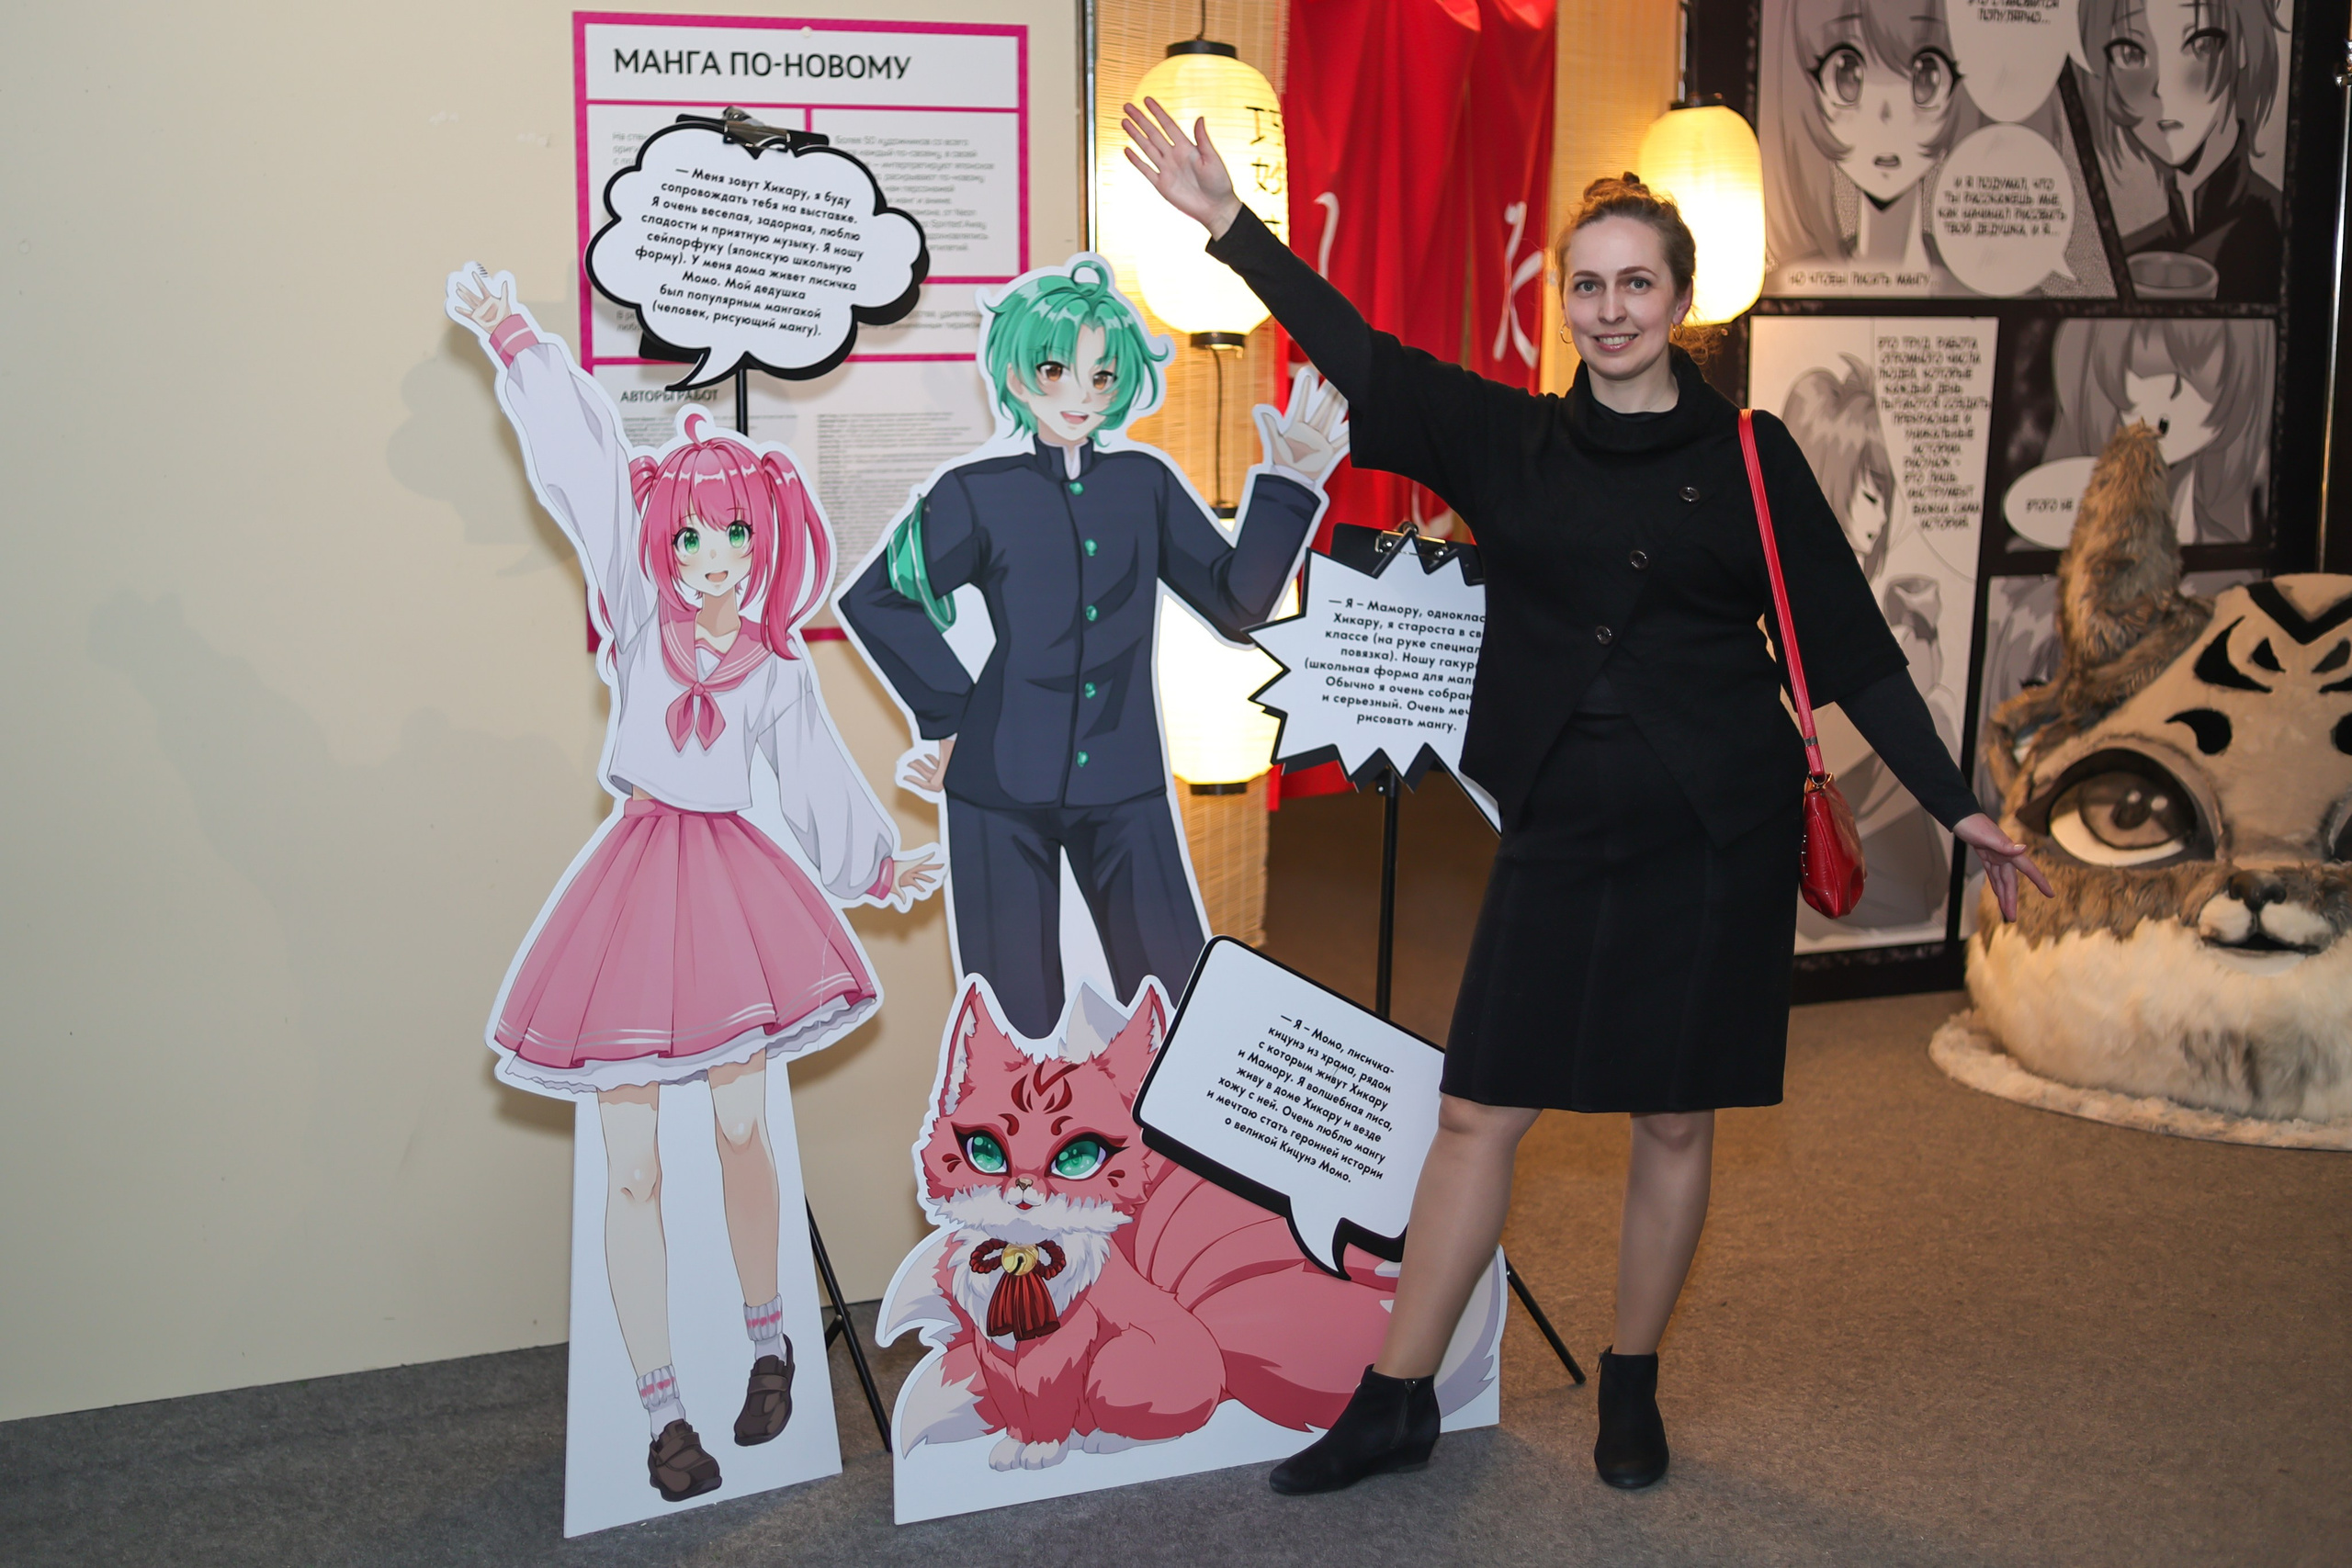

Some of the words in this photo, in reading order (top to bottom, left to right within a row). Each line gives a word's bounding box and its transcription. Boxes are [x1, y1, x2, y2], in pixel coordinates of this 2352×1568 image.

[613, 48, 721, 76] МАНГА
[730, 51, 911, 80] ПО-НОВОМУ
[661, 184, 747, 204] сопровождать
[753, 198, 778, 209] тебя
[800, 208, 856, 223] выставке.
[692, 169, 724, 182] Меня
[729, 178, 759, 191] зовут
[763, 181, 809, 200] Хикару,
[825, 192, 850, 208] буду
[641, 215, 697, 230] сладости
[712, 227, 769, 244] приятную
[773, 238, 818, 253] музыку.
[823, 243, 830, 252] Я
[834, 248, 863, 261] ношу
[652, 196, 659, 206] Я
[663, 201, 697, 213] очень
[702, 208, 752, 224] веселая,
[758, 217, 815, 234] задорная,
[820, 228, 860, 241] люблю
[636, 246, 686, 265] форму).
[692, 255, 699, 264] У
[703, 260, 731, 270] меня
[735, 265, 765, 276] дома
[769, 271, 805, 282] живет
[809, 277, 856, 290] лисичка
[647, 233, 723, 255] сейлорфуку
[728, 243, 788, 264] (японскую
[793, 258, 851, 275] школьную
[660, 284, 683, 297] был
[688, 292, 760, 309] популярным
[765, 305, 820, 318] мангакой
[682, 271, 720, 285] Момо.
[725, 278, 751, 290] Мой
[754, 285, 805, 299] дедушка
[653, 300, 708, 320] (человек,
[713, 313, 775, 328] рисующий
[779, 324, 820, 337] мангу).
[620, 390, 672, 402] АВТОРЫ
[676, 389, 718, 402] РАБОТ
[1334, 613, 1382, 630] Хикару,
[1398, 623, 1455, 635] староста
[1346, 598, 1353, 607] Я
[1367, 601, 1422, 618] Мамору,
[1326, 632, 1368, 641] классе
[1374, 633, 1392, 644] (на
[1397, 639, 1425, 649] руке
[1305, 658, 1369, 673] (школьная
[1374, 665, 1418, 680] форма
[1341, 649, 1397, 661] повязка).
[1403, 652, 1435, 668] Ношу
[1440, 659, 1476, 672] гакур
[1326, 677, 1374, 690] Обычно
[1390, 686, 1424, 695] очень
[1334, 696, 1401, 709] серьезный.
[1407, 701, 1444, 713] Очень
[1357, 714, 1413, 726] рисовать
[1418, 721, 1456, 733] мангу.
[1269, 1028, 1304, 1049] кицунэ
[1307, 1047, 1319, 1057] из
[1321, 1054, 1356, 1077] храма,
[1358, 1073, 1391, 1093] рядом
[1293, 1019, 1302, 1029] Я
[1311, 1028, 1343, 1053] Момо,
[1347, 1049, 1394, 1074] лисичка-
[1247, 1052, 1293, 1083] Мамору.
[1297, 1077, 1306, 1086] Я
[1306, 1083, 1363, 1115] волшебная
[1365, 1112, 1392, 1131] лиса,
[1267, 1045, 1312, 1073] которым
[1315, 1069, 1347, 1089] живут
[1349, 1083, 1388, 1111] Хикару
[1218, 1077, 1246, 1097] хожу
[1257, 1096, 1277, 1111] ней.
[1283, 1106, 1313, 1128] Очень
[1316, 1125, 1352, 1146] люблю
[1354, 1144, 1385, 1165] мангу
[1237, 1068, 1264, 1088] живу
[1273, 1086, 1300, 1103] доме
[1303, 1097, 1342, 1125] Хикару
[1353, 1124, 1381, 1142] везде
[1216, 1096, 1257, 1118] мечтаю
[1260, 1116, 1287, 1134] стать
[1290, 1131, 1339, 1158] героиней
[1341, 1155, 1383, 1179] истории
[1234, 1122, 1278, 1147] великой
[1279, 1141, 1316, 1165] Кицунэ
[1318, 1160, 1351, 1182] Момо.
